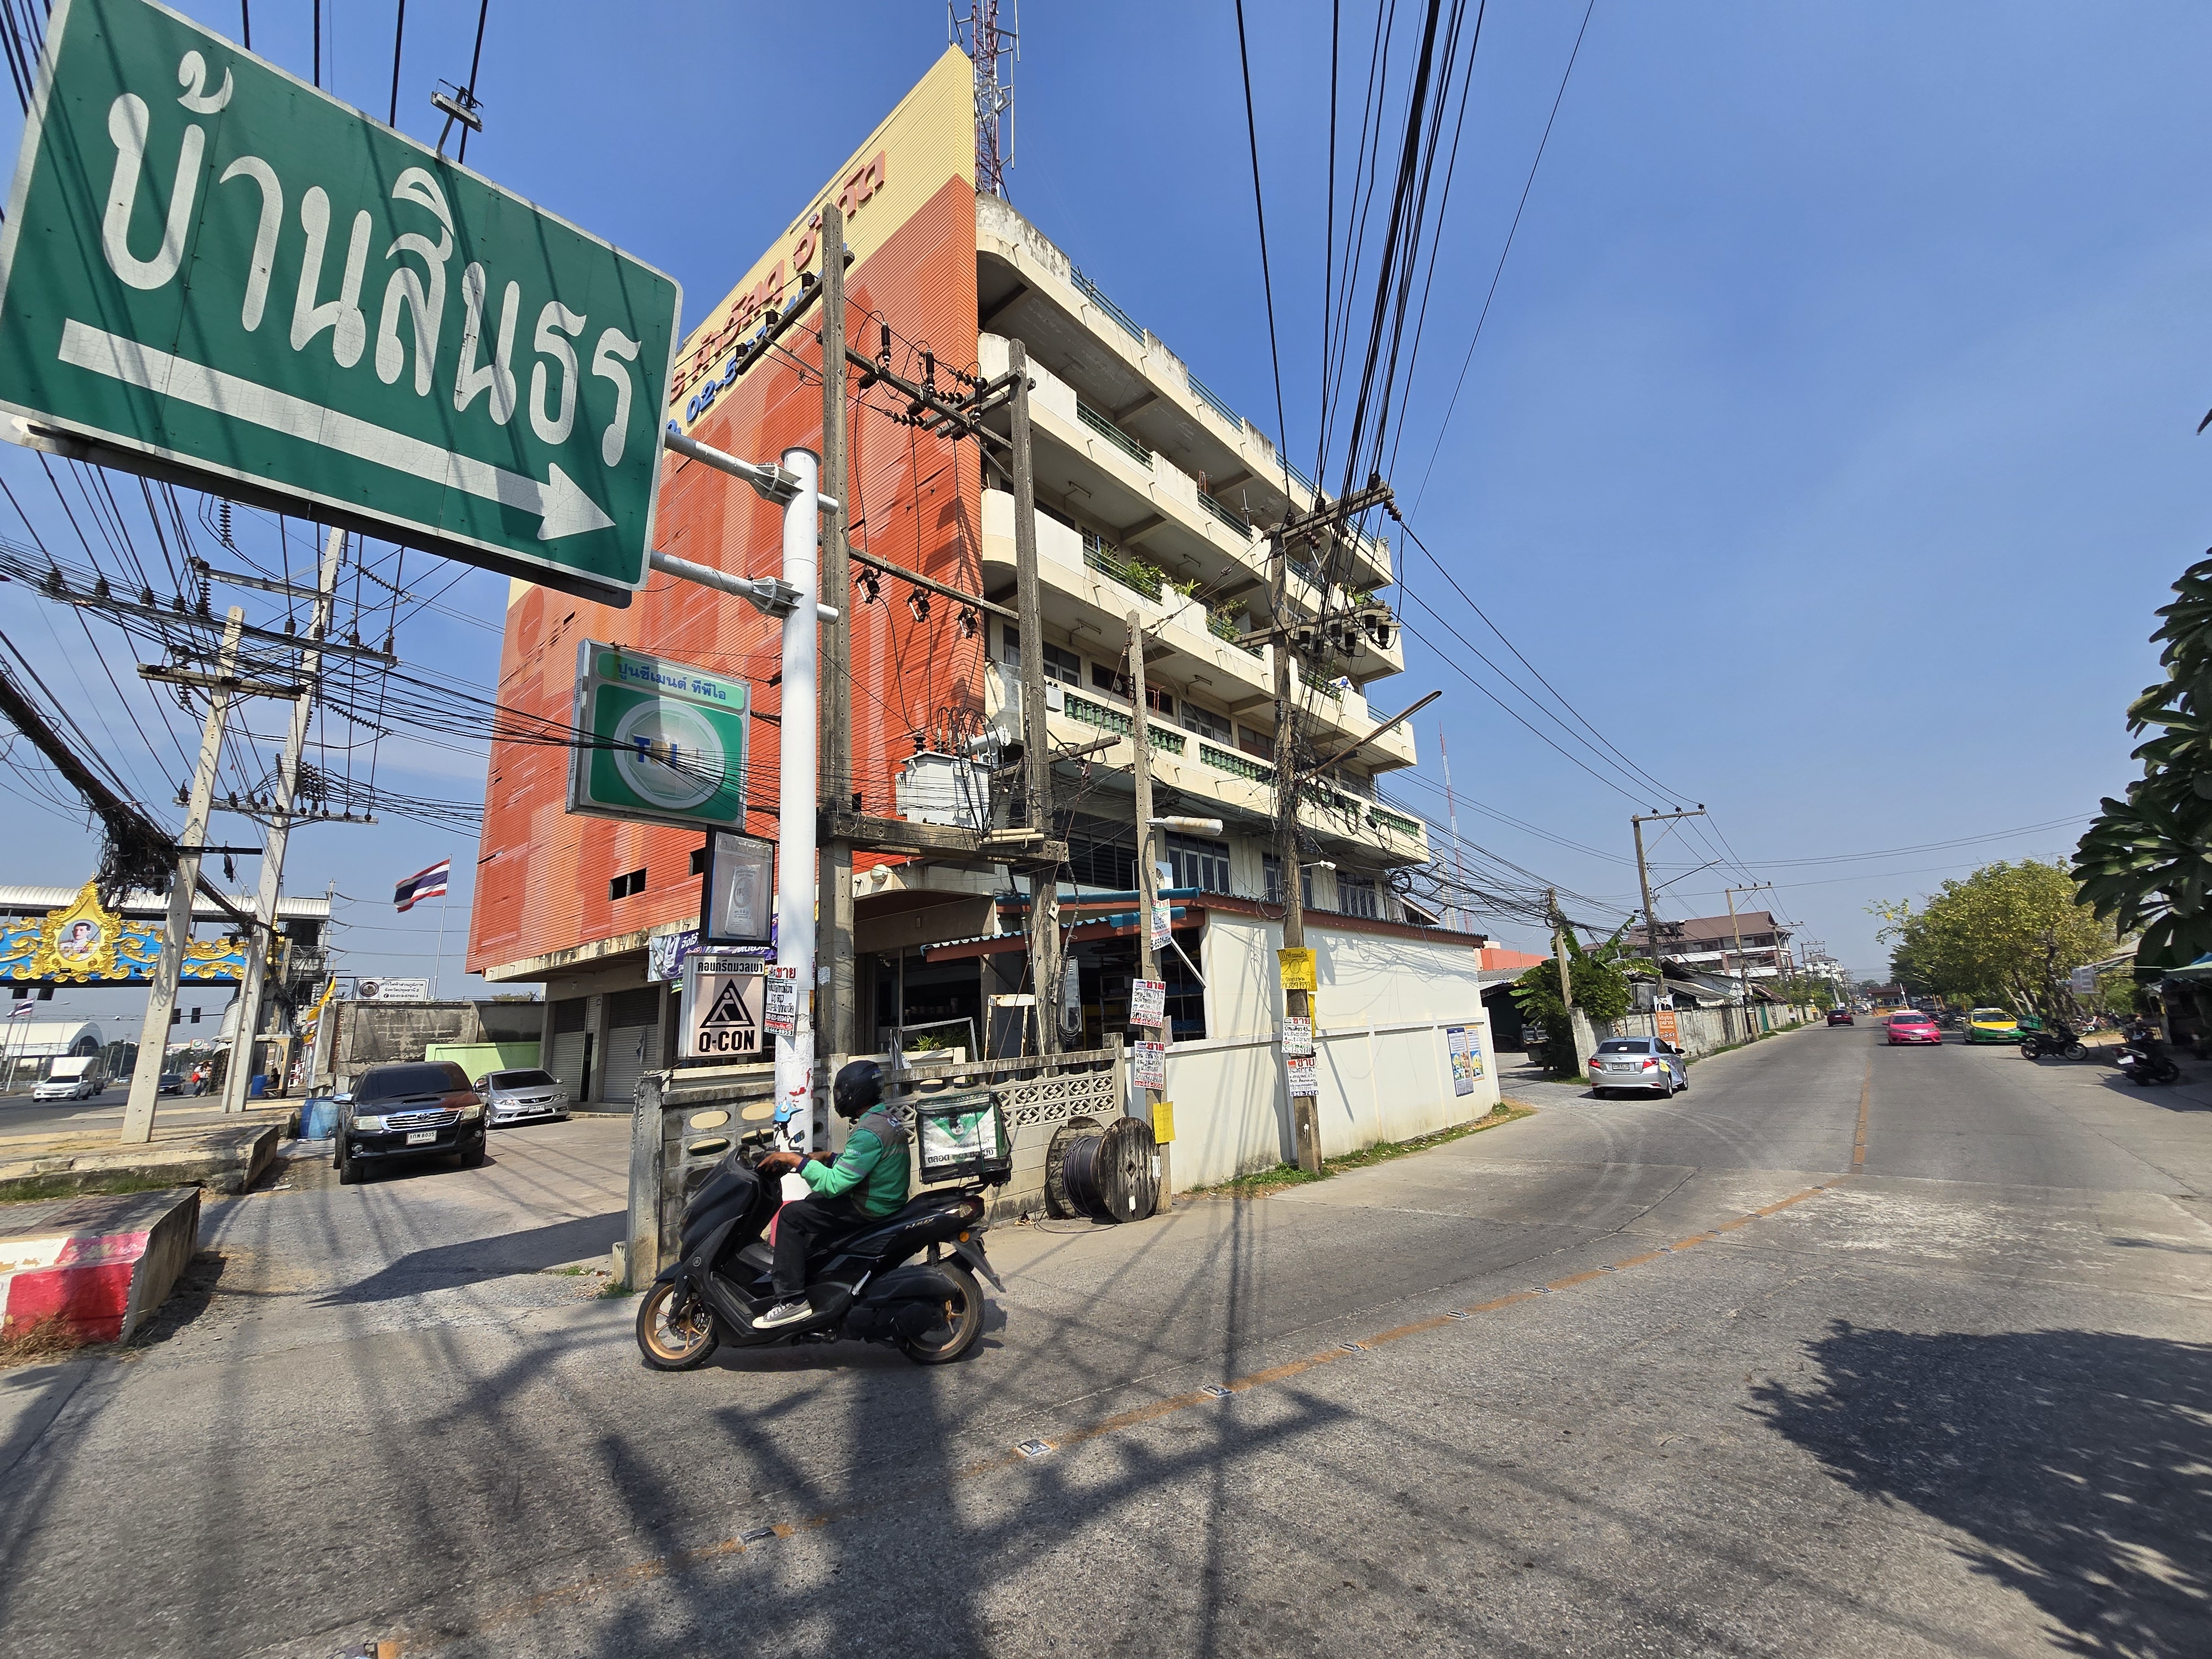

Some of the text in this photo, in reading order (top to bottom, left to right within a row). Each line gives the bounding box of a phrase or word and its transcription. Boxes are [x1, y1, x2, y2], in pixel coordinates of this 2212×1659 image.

[102, 50, 641, 467] บ้านสินธร
[691, 679, 726, 700] ทีพีไอ
[698, 959, 763, 973] คอนกรีตมวลเบา
[776, 967, 796, 979] ขาย
[1146, 980, 1165, 990] ขาย
[699, 1029, 755, 1052] Q-CON
[1147, 1042, 1165, 1051] ขาย
[1297, 1058, 1315, 1067] ขาย
